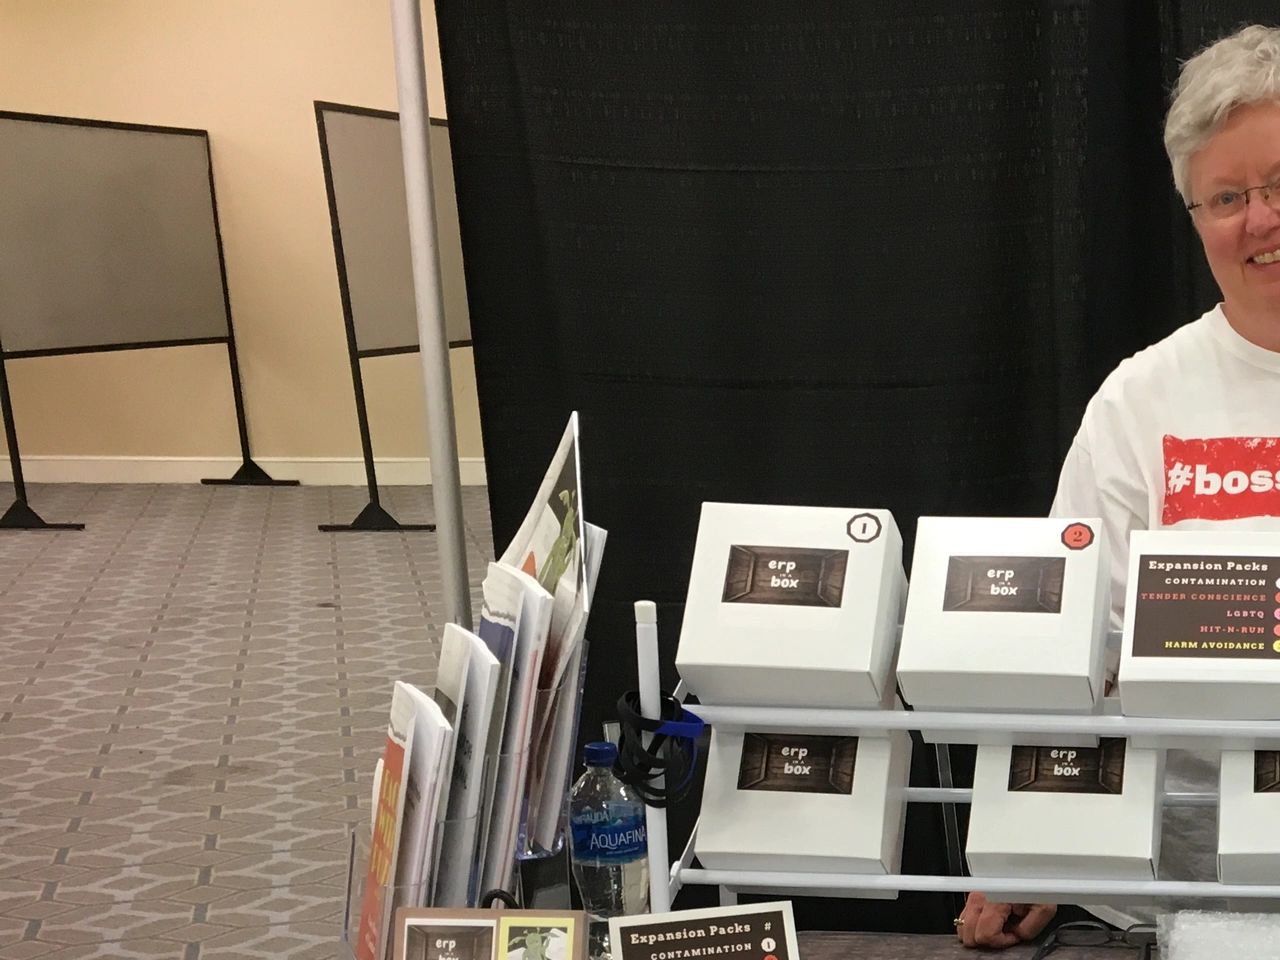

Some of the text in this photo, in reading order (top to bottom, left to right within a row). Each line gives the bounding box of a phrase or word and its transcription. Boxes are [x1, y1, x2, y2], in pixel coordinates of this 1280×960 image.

[1073, 530, 1083, 542] 2
[768, 560, 796, 573] erp
[1148, 560, 1223, 572] Expansion
[1226, 562, 1268, 571] Packs
[987, 569, 1015, 581] erp
[770, 575, 799, 588] box
[1164, 577, 1266, 586] CONTAMINATION
[990, 583, 1018, 596] box
[1140, 592, 1187, 601] TENDER
[1191, 593, 1267, 602] CONSCIENCE
[1226, 610, 1265, 619] LGBTQ
[1200, 625, 1265, 634] HIT-N-RUN
[1164, 641, 1198, 649] HARM
[1201, 642, 1265, 650] AVOIDANCE
[781, 746, 808, 760] erp
[1050, 749, 1077, 762] erp
[783, 762, 812, 775] box
[1053, 764, 1081, 776] box
[630, 927, 706, 945] Expansion
[709, 922, 751, 936] Packs
[435, 938, 456, 951] erp
[650, 942, 753, 960] CONTAMINATION
